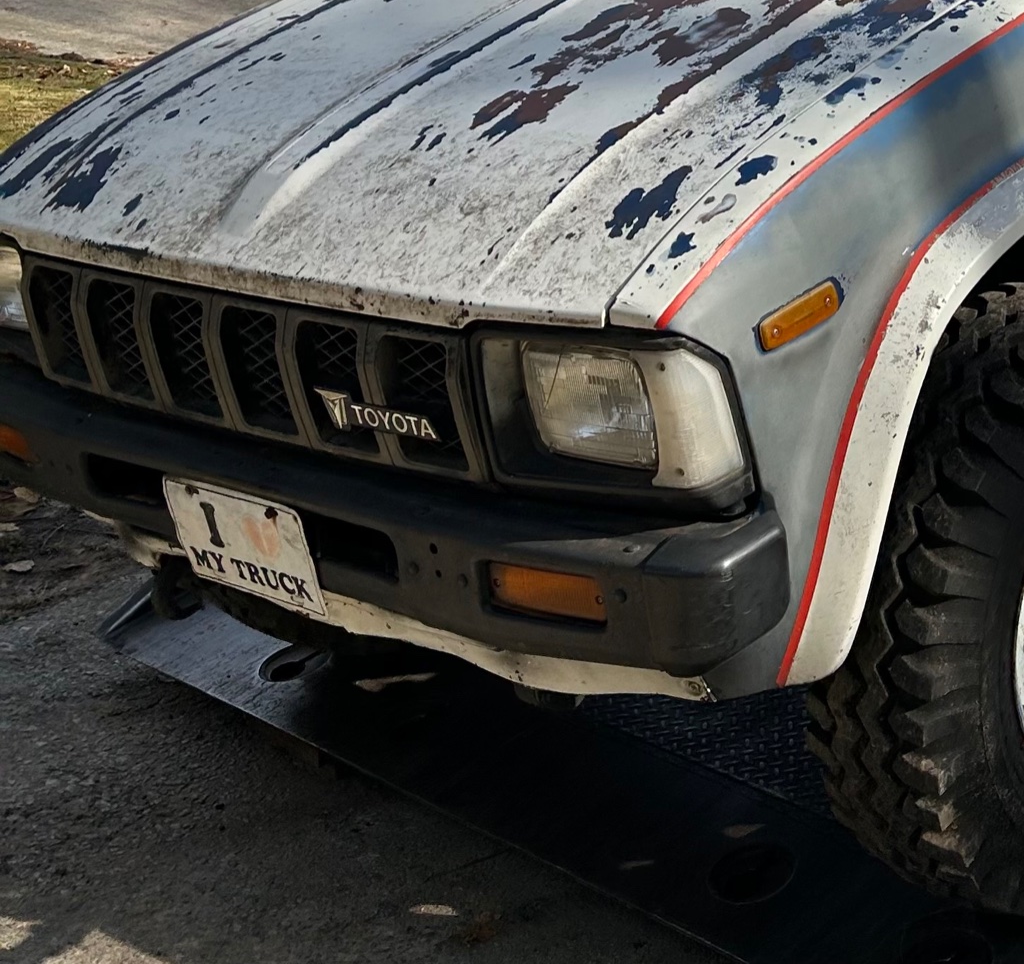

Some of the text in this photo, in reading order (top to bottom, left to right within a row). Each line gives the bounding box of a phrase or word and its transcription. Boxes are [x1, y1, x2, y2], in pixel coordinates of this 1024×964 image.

[350, 404, 437, 439] TOYOTA
[199, 501, 225, 548] I
[190, 545, 314, 603] MY TRUCK
